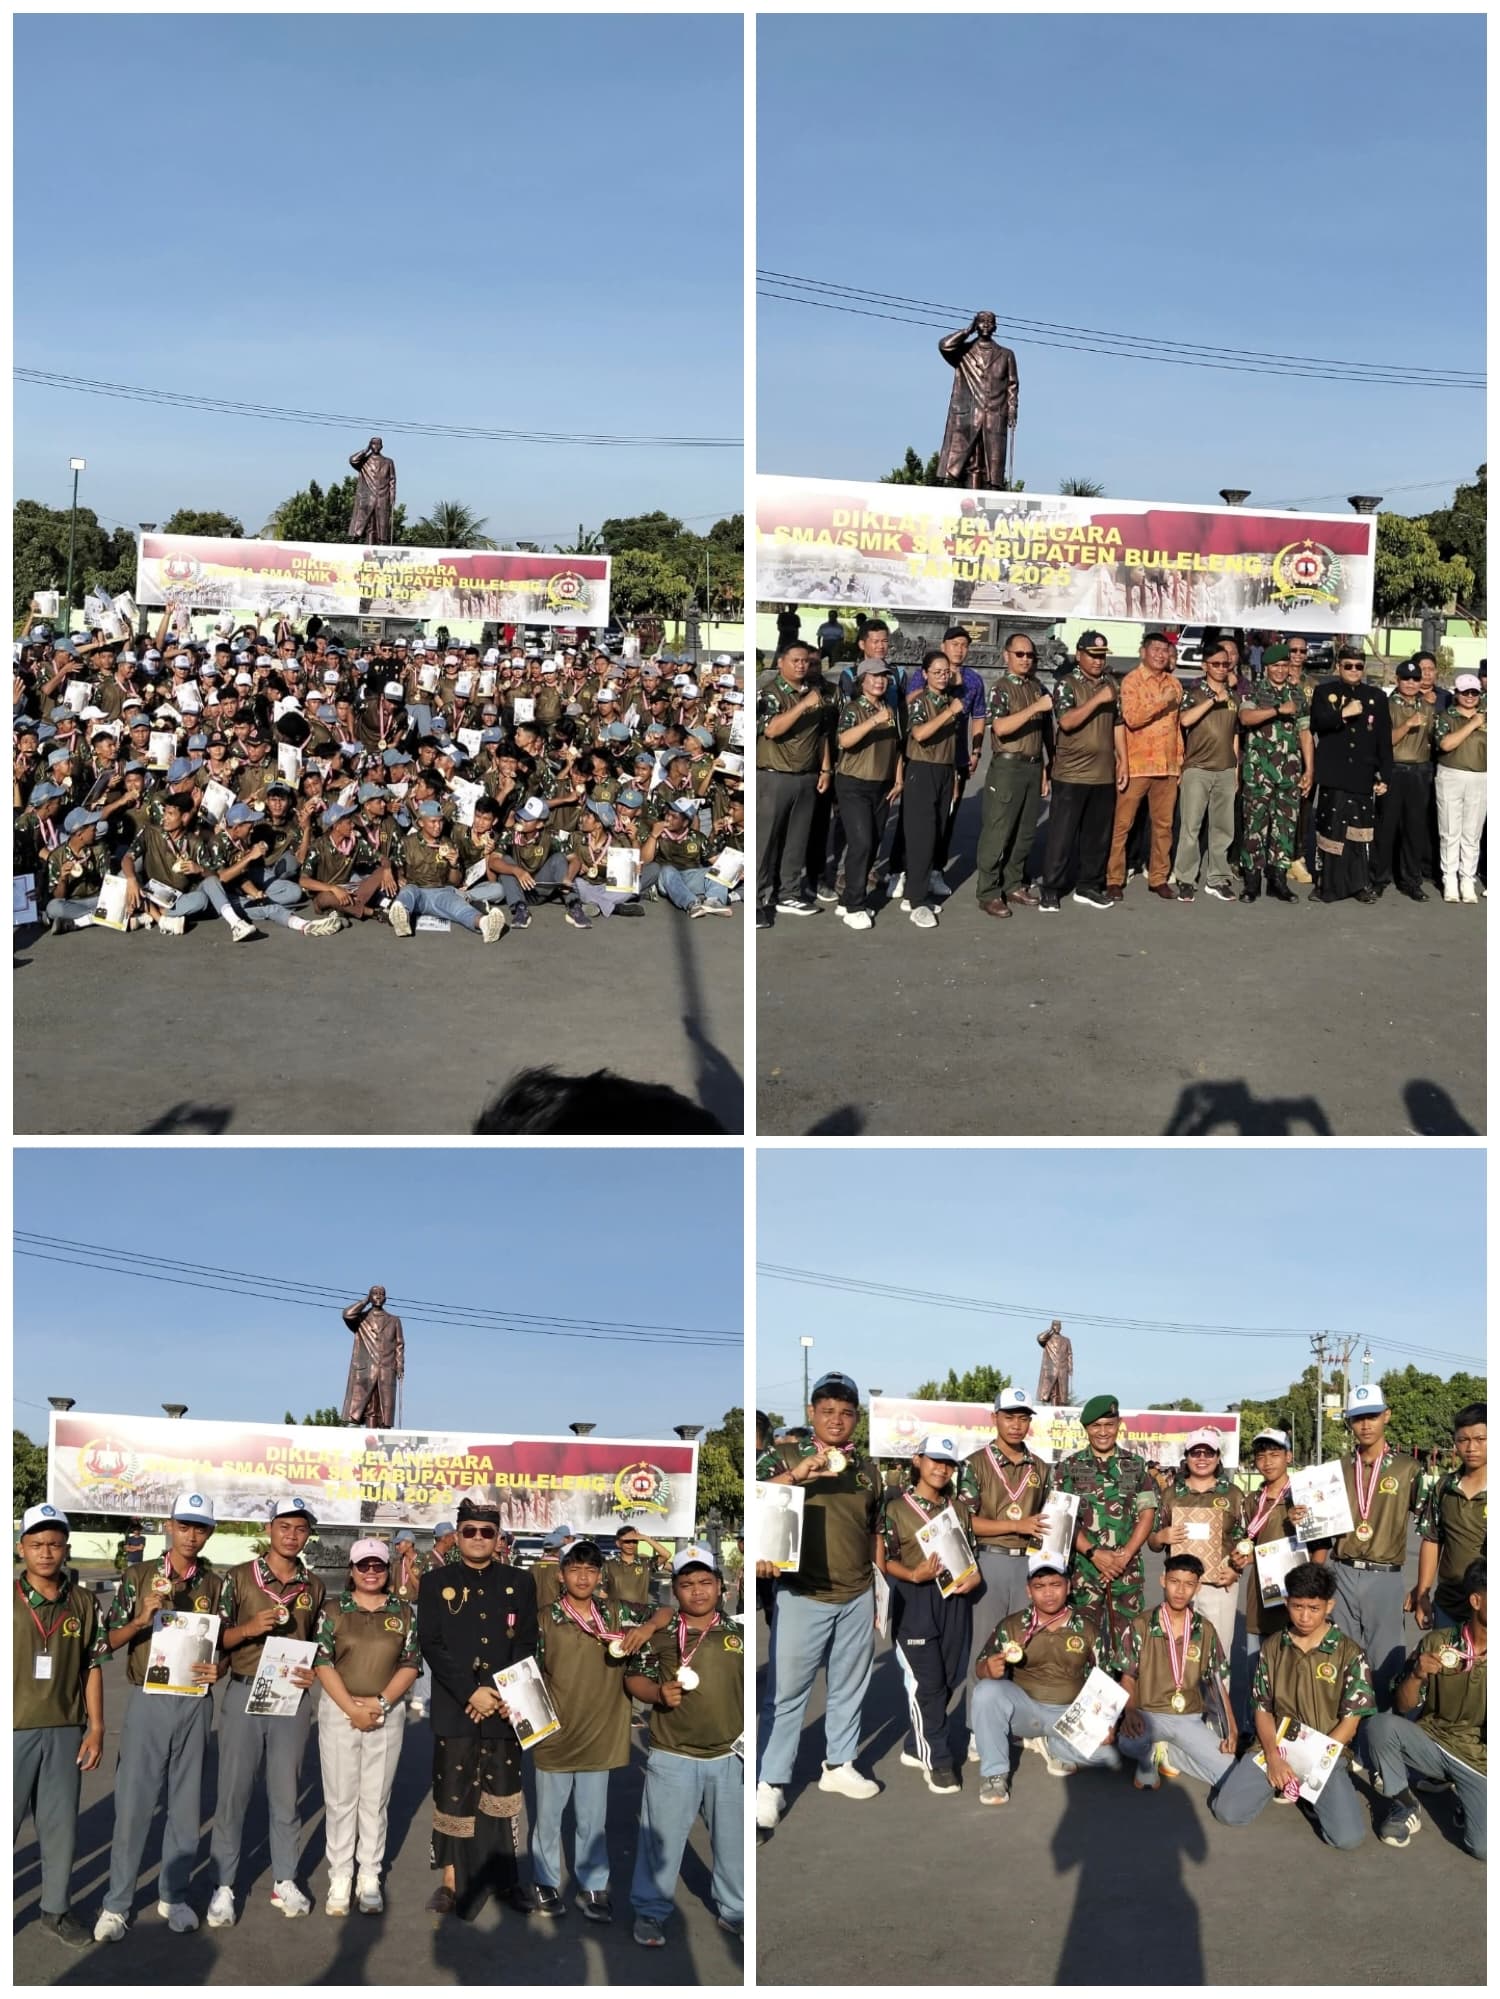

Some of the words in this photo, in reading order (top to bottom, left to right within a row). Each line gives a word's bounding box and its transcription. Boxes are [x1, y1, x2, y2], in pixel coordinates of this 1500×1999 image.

[833, 509, 928, 533] DIKLAT
[943, 514, 1122, 545] BELANEGARA
[774, 526, 903, 552] SMA/SMK
[912, 535, 1116, 565] SE-KABUPATEN
[1125, 548, 1263, 574] BULELENG
[260, 568, 331, 582] SMA/SMK
[909, 558, 999, 582] TAHUN
[1009, 564, 1071, 586] 2025
[334, 584, 386, 598] HUN
[266, 1446, 343, 1464] DIKLAT
[352, 1448, 493, 1470] BELANEGARA
[222, 1460, 320, 1479] SMA/SMK
[495, 1473, 606, 1491] BULELENG
[326, 1484, 396, 1502] TAHUN
